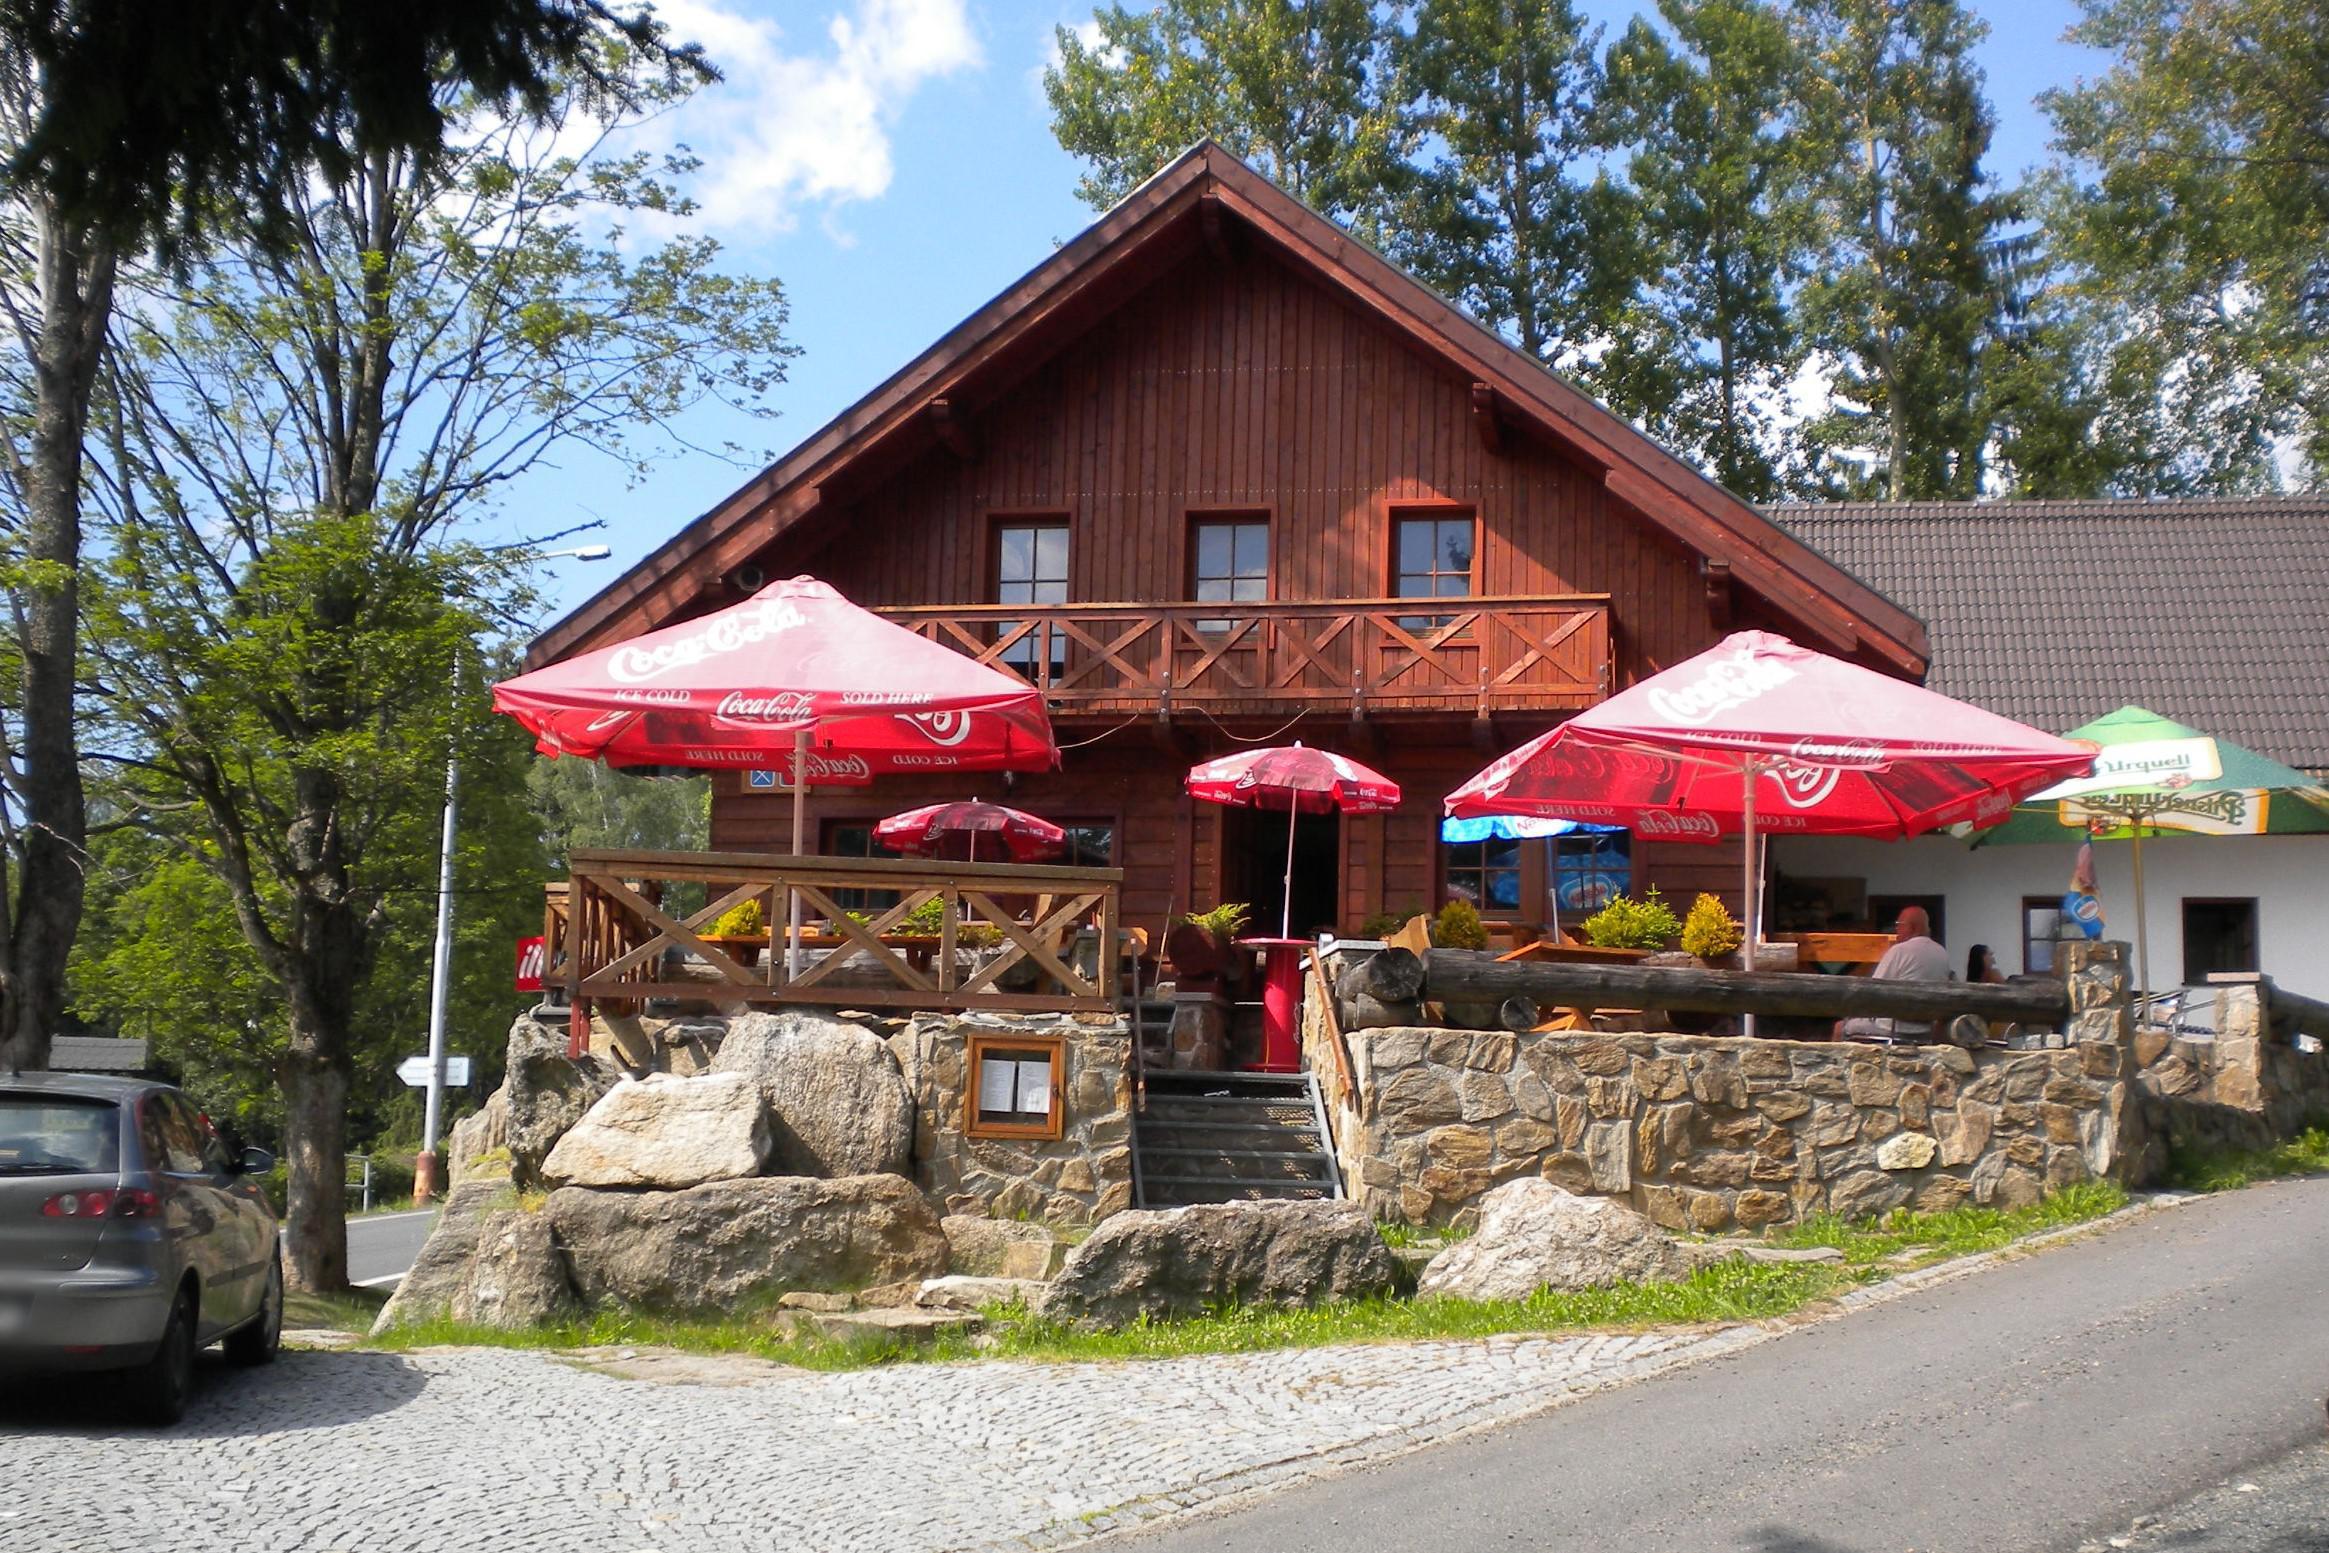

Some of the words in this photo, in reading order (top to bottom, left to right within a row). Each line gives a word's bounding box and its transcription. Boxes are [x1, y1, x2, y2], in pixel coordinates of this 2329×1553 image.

[614, 690, 641, 702] ICE
[646, 690, 691, 703] COLD
[840, 692, 883, 705] SOLD
[886, 693, 934, 705] HERE
[2104, 753, 2192, 773] Urquell
